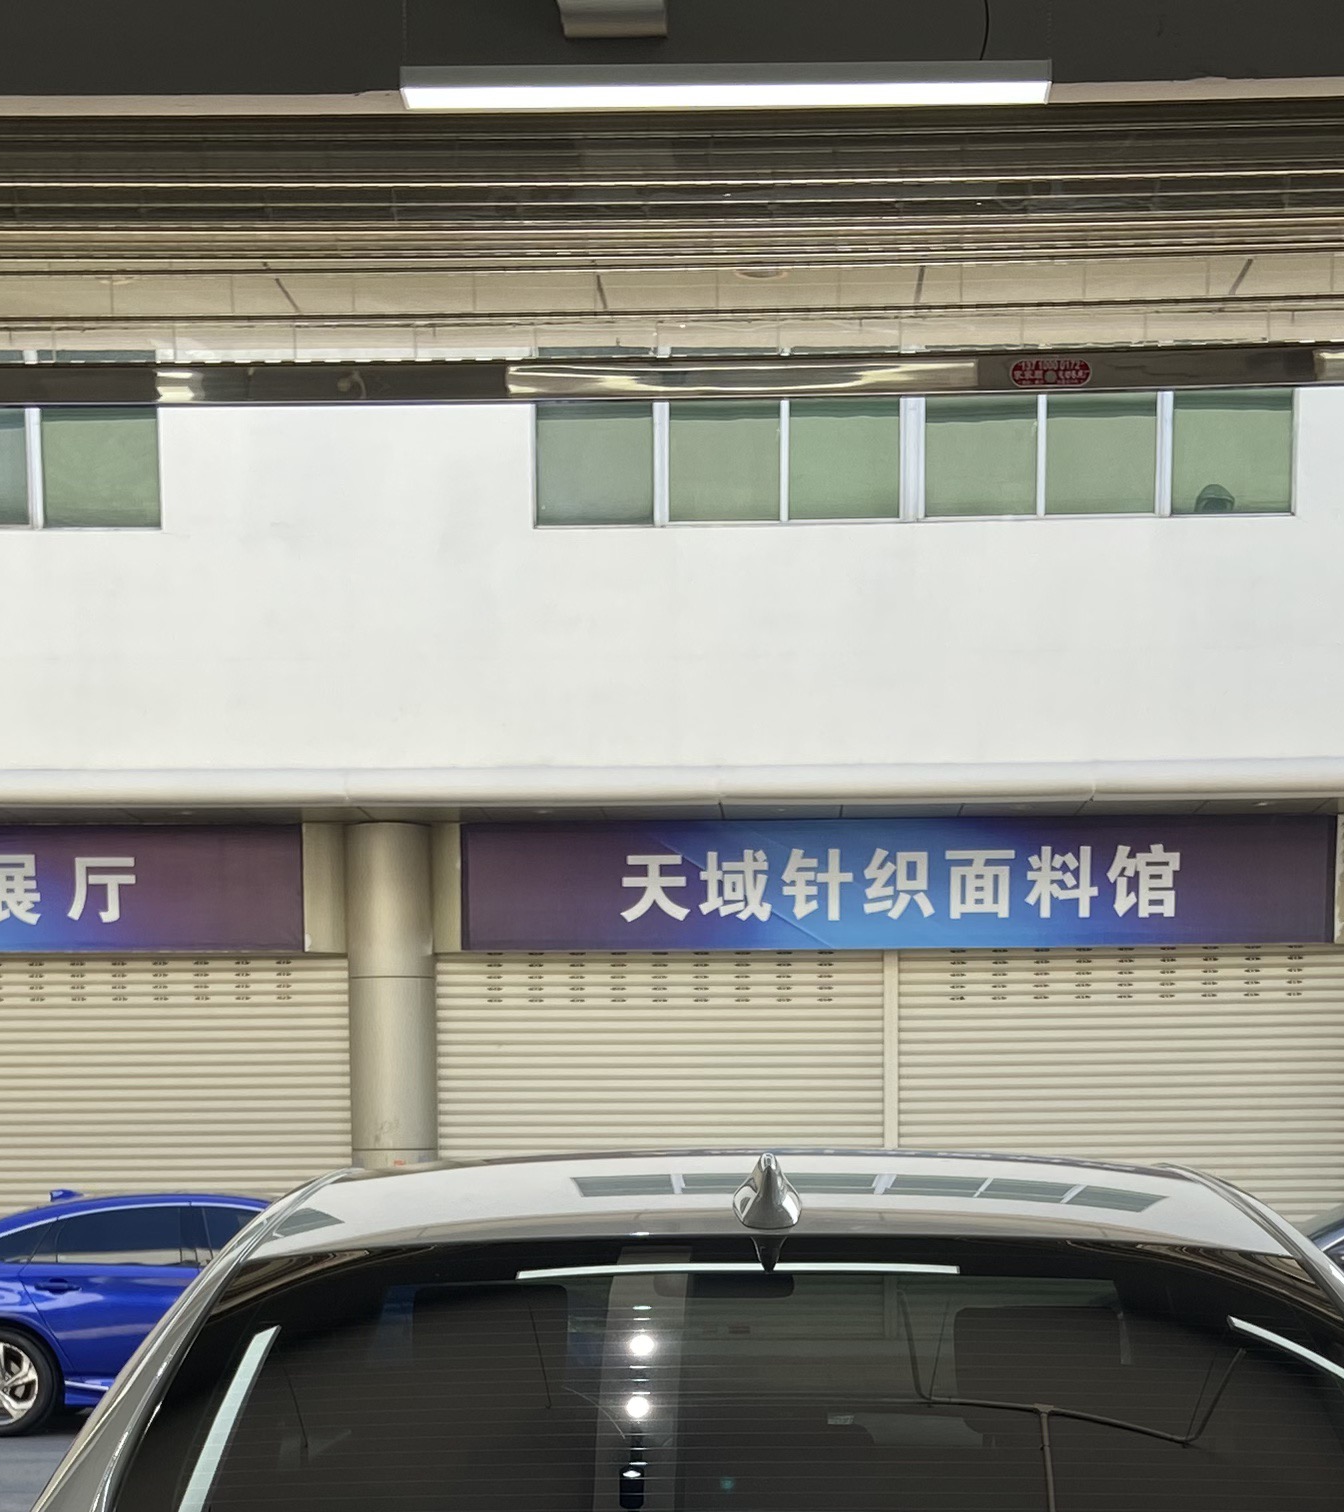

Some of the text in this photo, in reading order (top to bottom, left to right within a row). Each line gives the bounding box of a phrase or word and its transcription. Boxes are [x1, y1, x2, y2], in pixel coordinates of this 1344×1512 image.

[620, 844, 1182, 923] 天域针织面料馆
